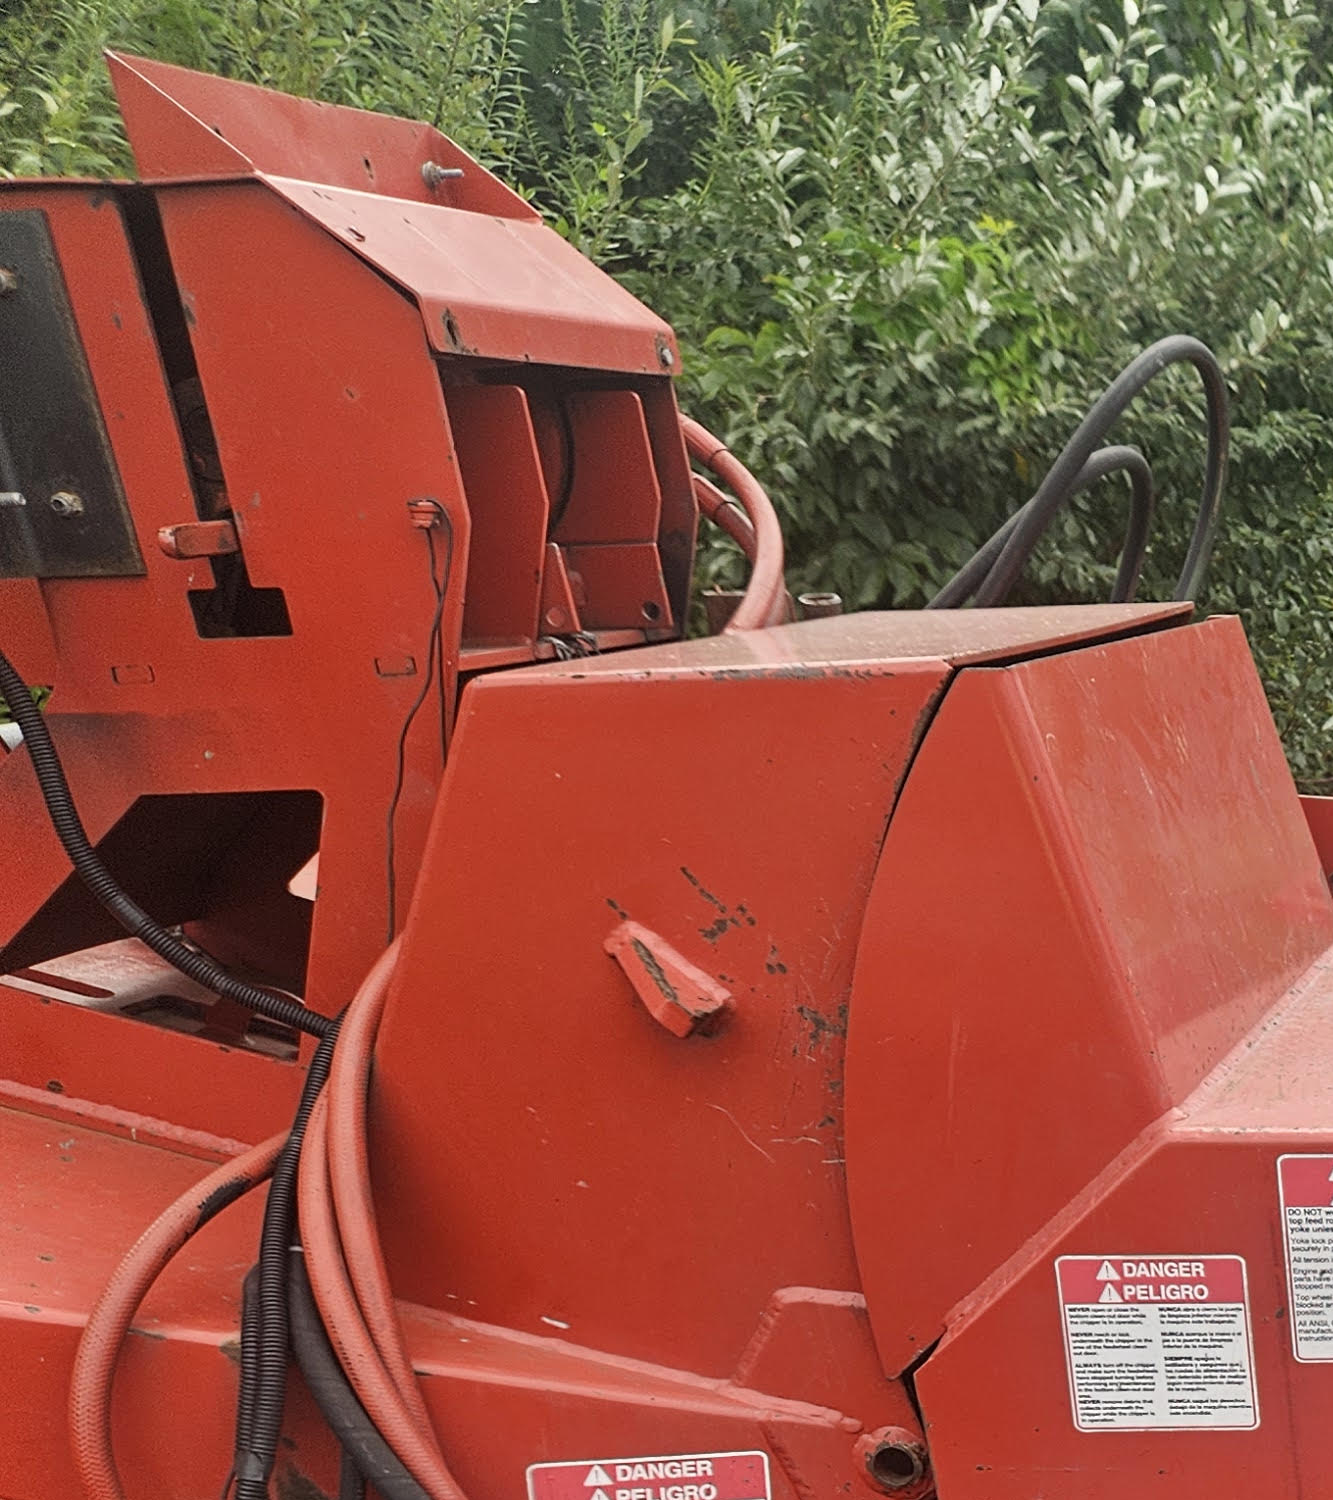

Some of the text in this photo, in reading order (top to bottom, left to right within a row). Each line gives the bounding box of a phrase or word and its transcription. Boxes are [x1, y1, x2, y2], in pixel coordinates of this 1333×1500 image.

[1288, 1216, 1303, 1225] top
[1304, 1216, 1323, 1224] feed
[1289, 1225, 1310, 1234] yoke
[1121, 1262, 1205, 1277] DANGER
[1122, 1284, 1209, 1300] PELIGRO
[614, 1460, 713, 1482] DANGER
